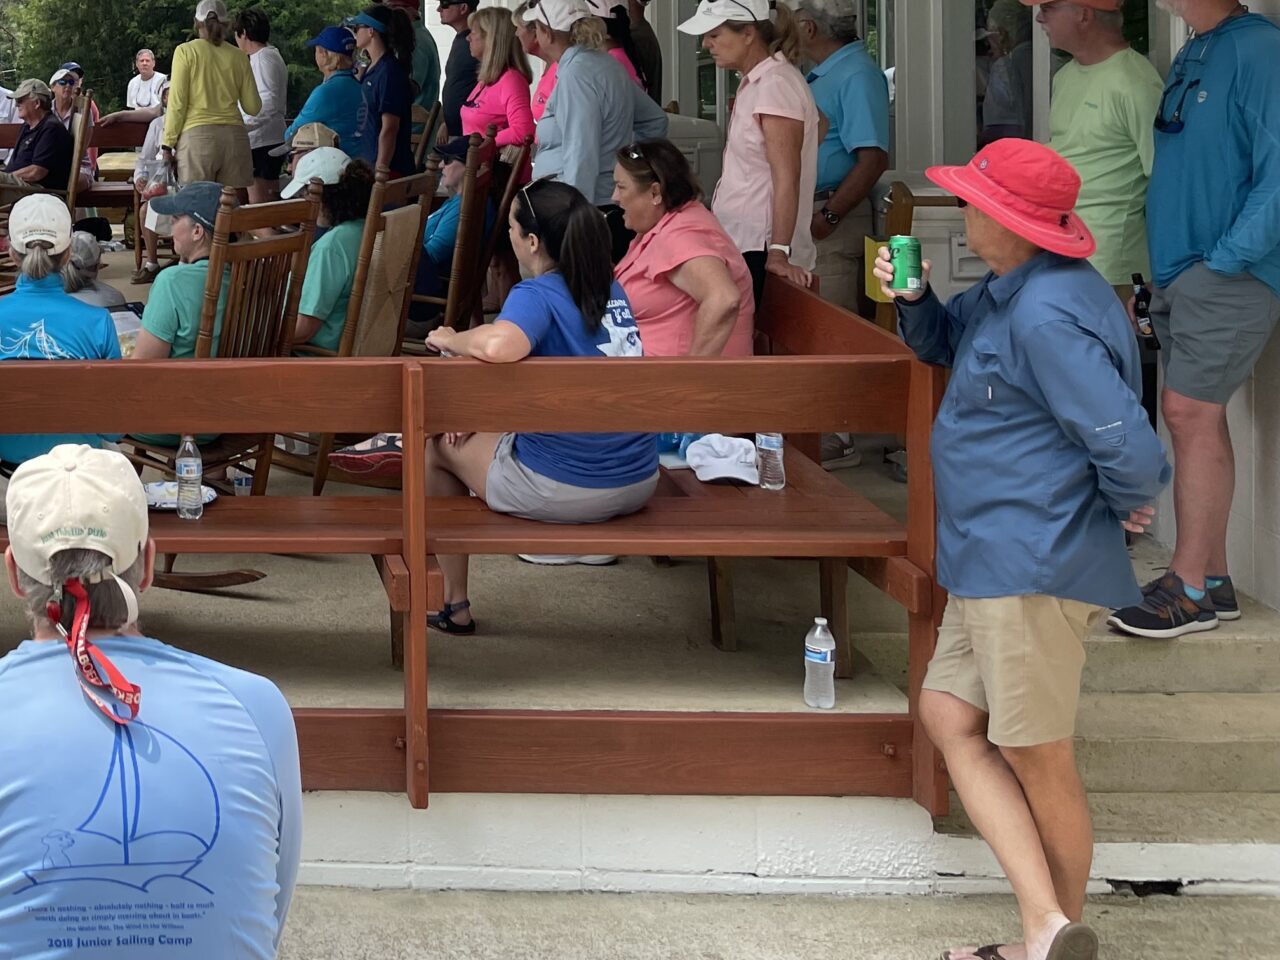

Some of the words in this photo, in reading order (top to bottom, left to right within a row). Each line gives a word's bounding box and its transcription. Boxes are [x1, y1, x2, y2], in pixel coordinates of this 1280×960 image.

[76, 937, 113, 949] Junior
[116, 934, 155, 946] Sailing
[158, 934, 193, 947] Camp
